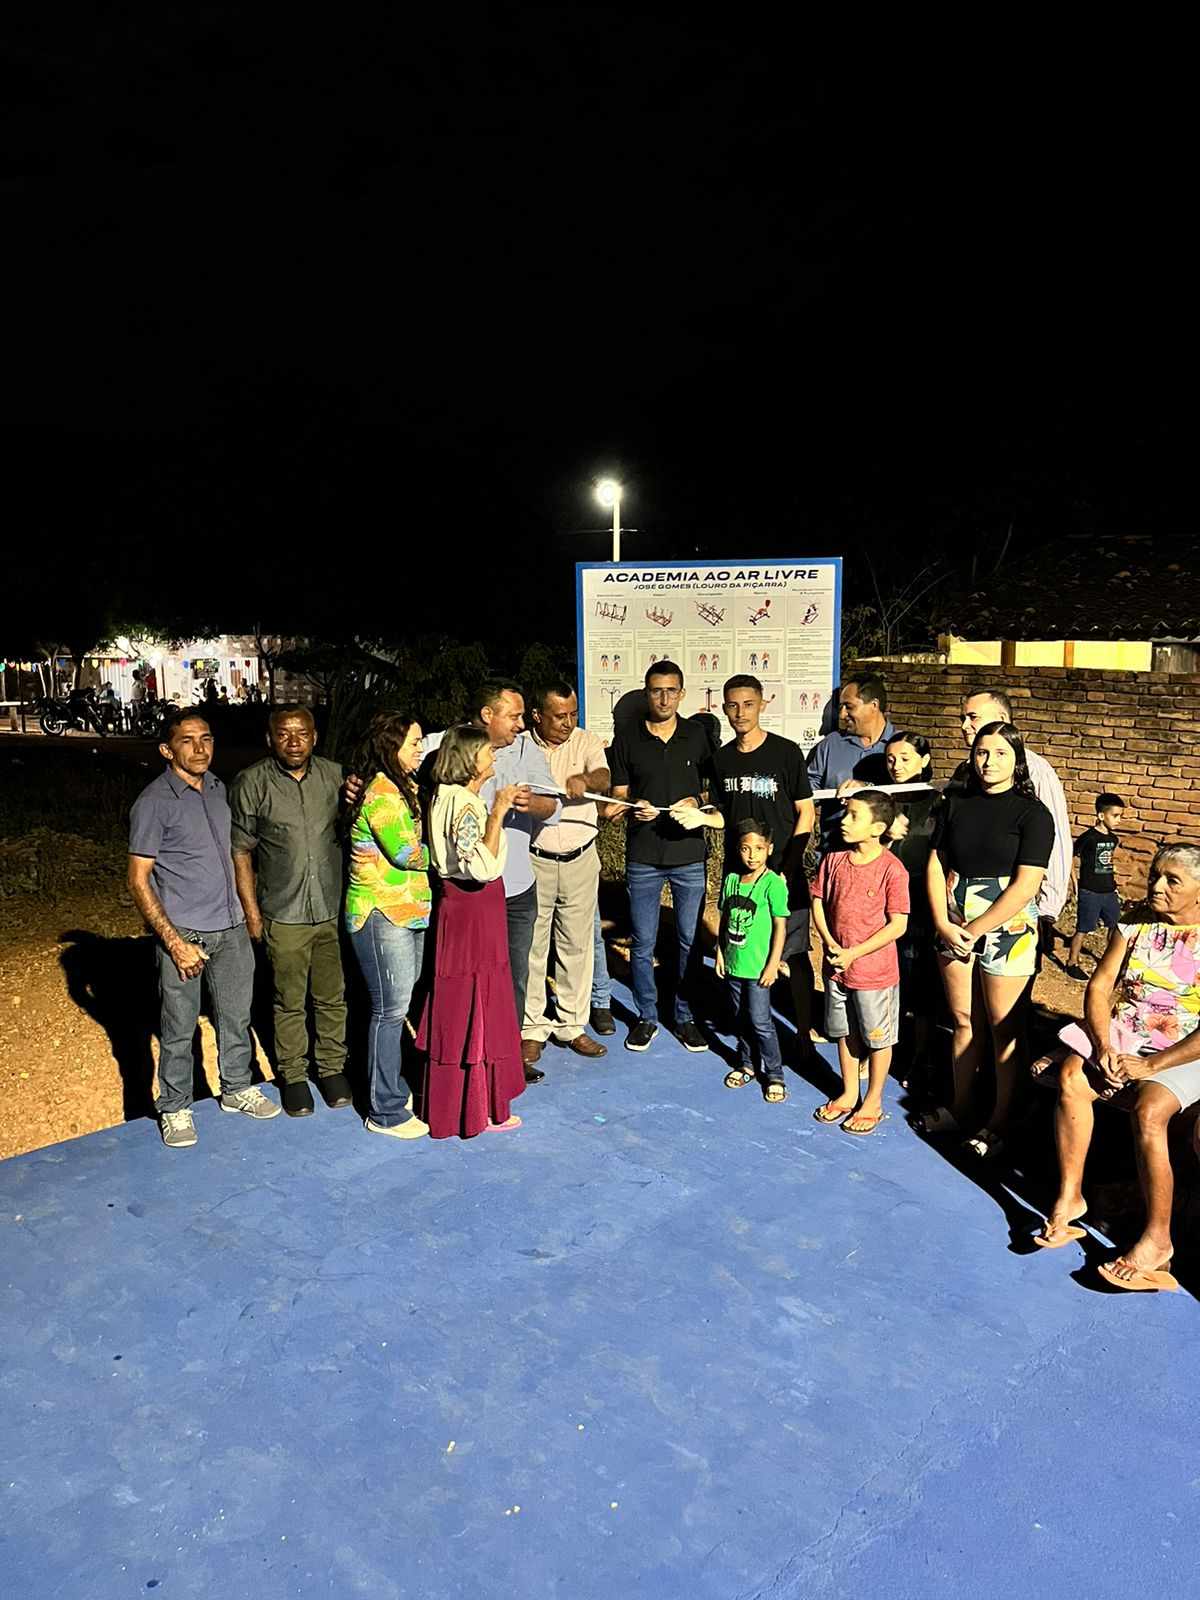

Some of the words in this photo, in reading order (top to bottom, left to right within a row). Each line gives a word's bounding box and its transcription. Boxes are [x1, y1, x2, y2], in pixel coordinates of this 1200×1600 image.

[604, 572, 699, 582] ACADEMIA
[704, 571, 730, 580] AO
[735, 571, 760, 580] AR
[764, 570, 819, 580] LIVRE
[692, 582, 727, 590] (LOURO
[724, 777, 739, 792] All
